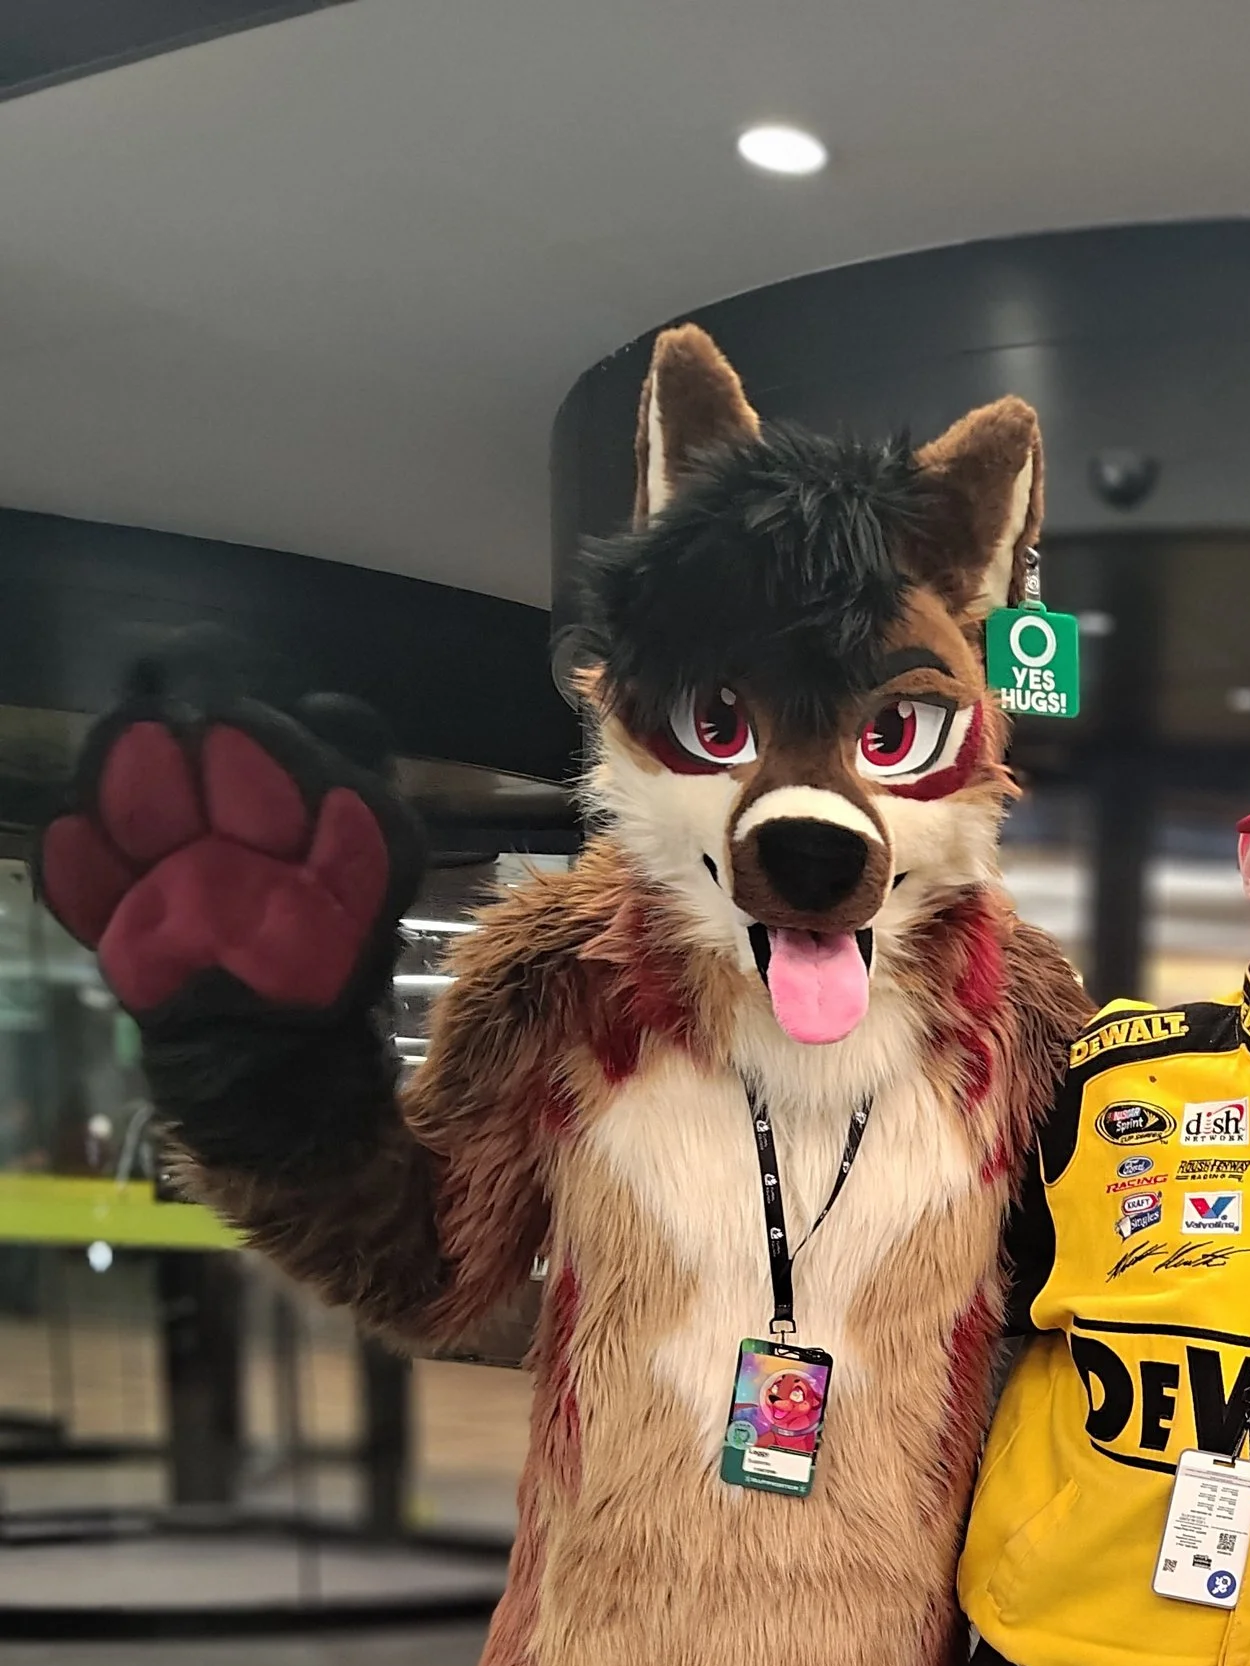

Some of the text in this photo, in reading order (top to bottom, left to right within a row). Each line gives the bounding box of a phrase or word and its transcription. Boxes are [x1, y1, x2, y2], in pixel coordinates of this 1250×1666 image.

[1011, 666, 1056, 691] YES
[1000, 687, 1067, 713] HUGS!
[1115, 1116, 1144, 1133] Sprint
[1185, 1107, 1243, 1136] dish
[1185, 1134, 1244, 1142] NETWORK
[1122, 1159, 1148, 1175] Ford
[1106, 1173, 1169, 1194] RACING
[1127, 1197, 1151, 1210] KRAFT
[1131, 1210, 1160, 1230] Singles
